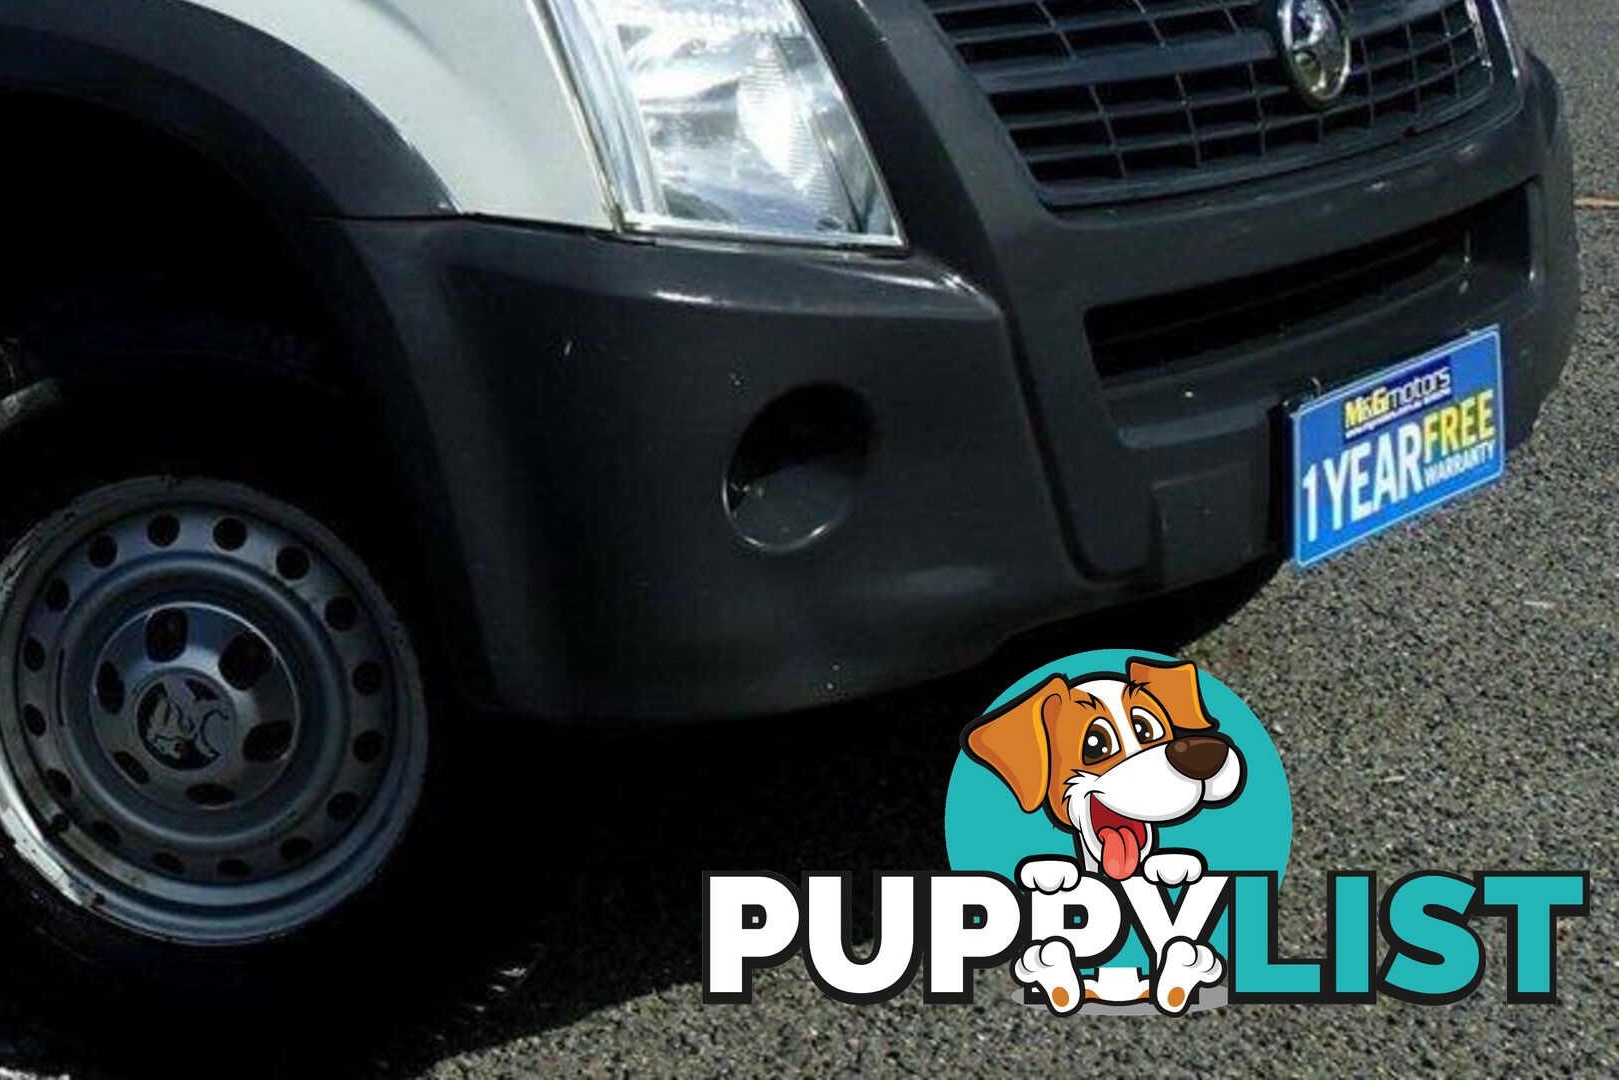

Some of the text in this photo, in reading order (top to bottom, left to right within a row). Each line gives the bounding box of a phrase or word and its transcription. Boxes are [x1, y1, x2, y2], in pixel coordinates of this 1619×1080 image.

[1302, 463, 1318, 542] 1
[1323, 422, 1424, 531] YEAR
[1423, 389, 1495, 464] FREE
[1424, 439, 1496, 488] WARRANTY
